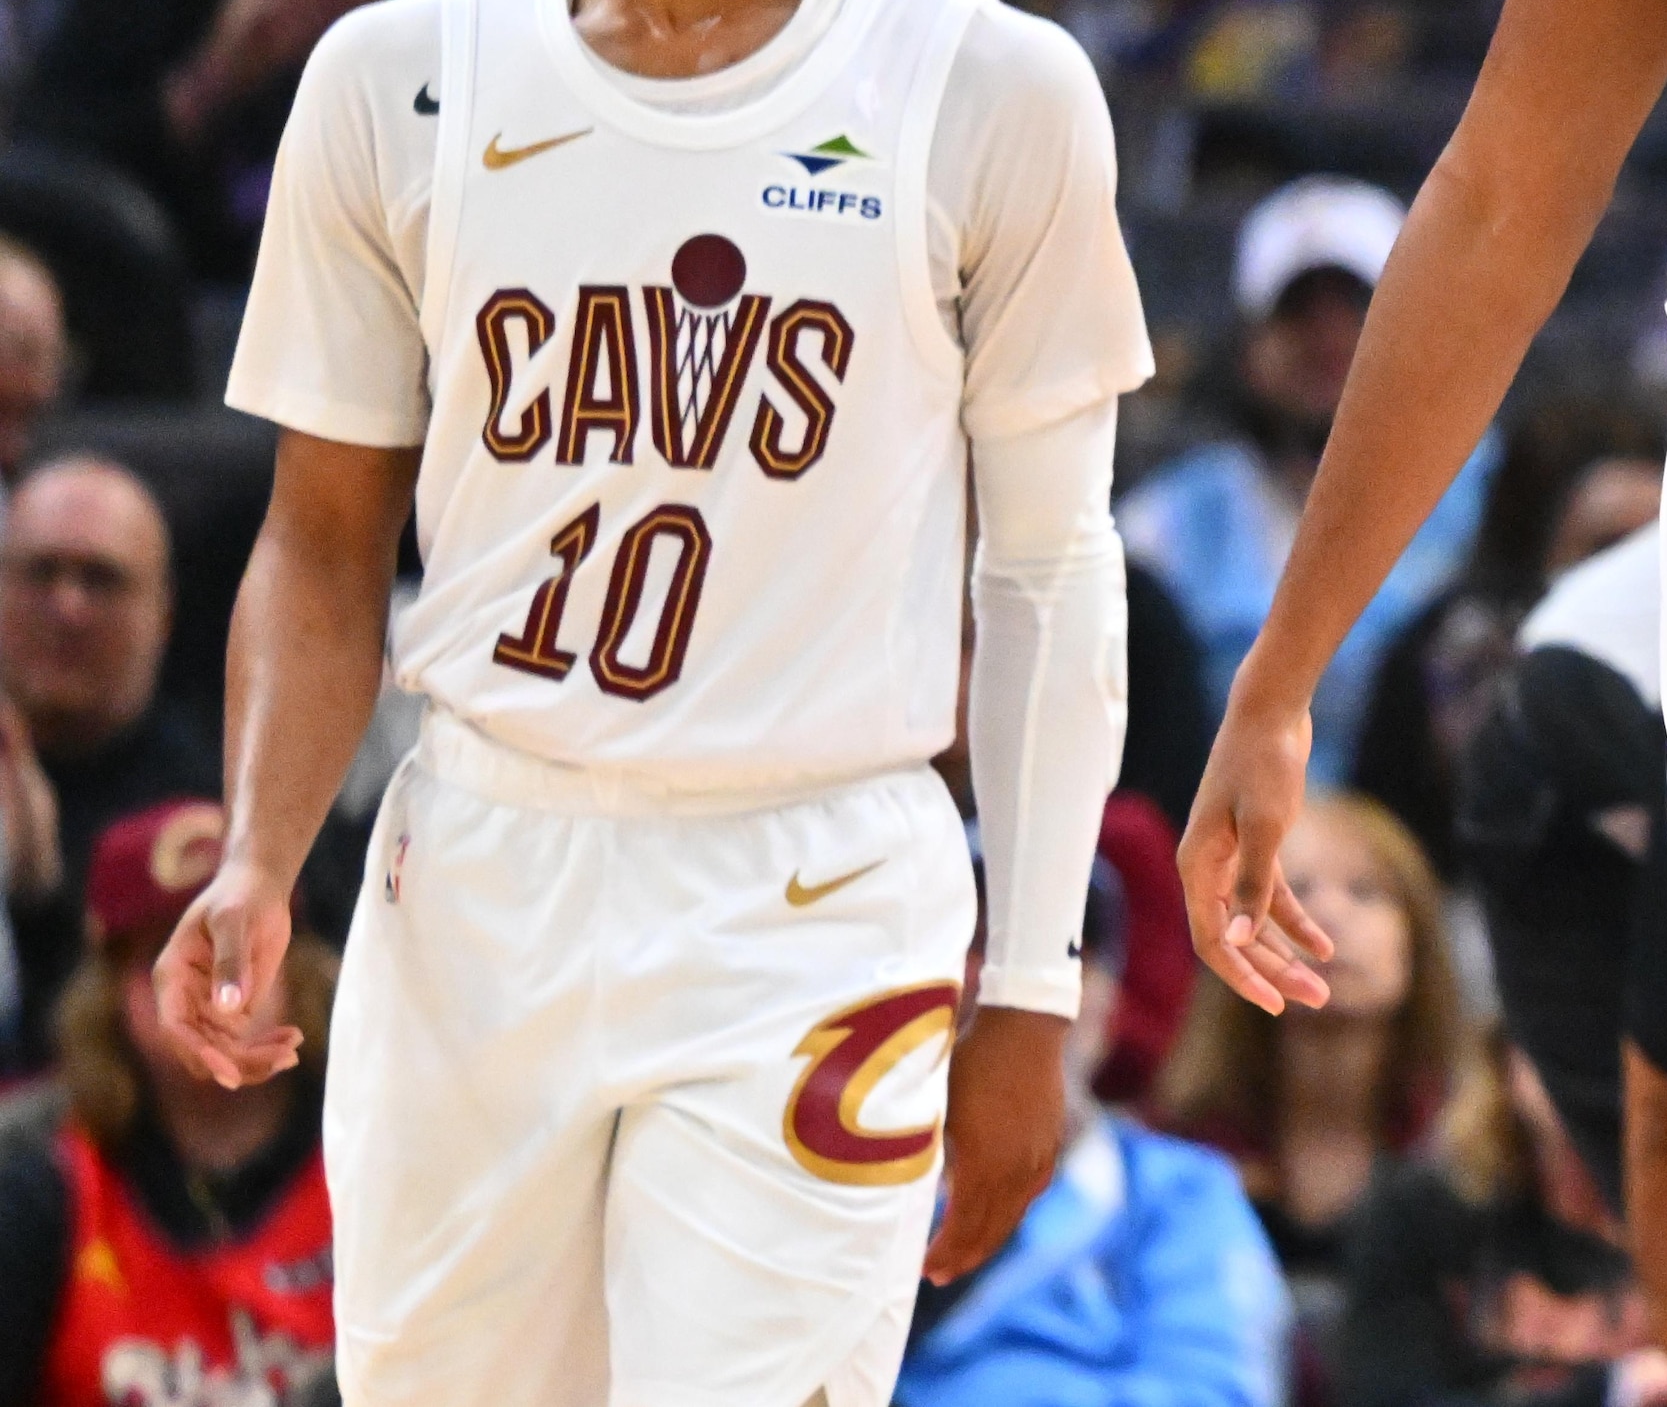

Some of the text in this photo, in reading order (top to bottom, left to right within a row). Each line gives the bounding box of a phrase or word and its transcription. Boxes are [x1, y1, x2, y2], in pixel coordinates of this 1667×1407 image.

[762, 185, 882, 220] CLIFFS
[475, 284, 855, 482] CAVS
[491, 501, 712, 703] 10
